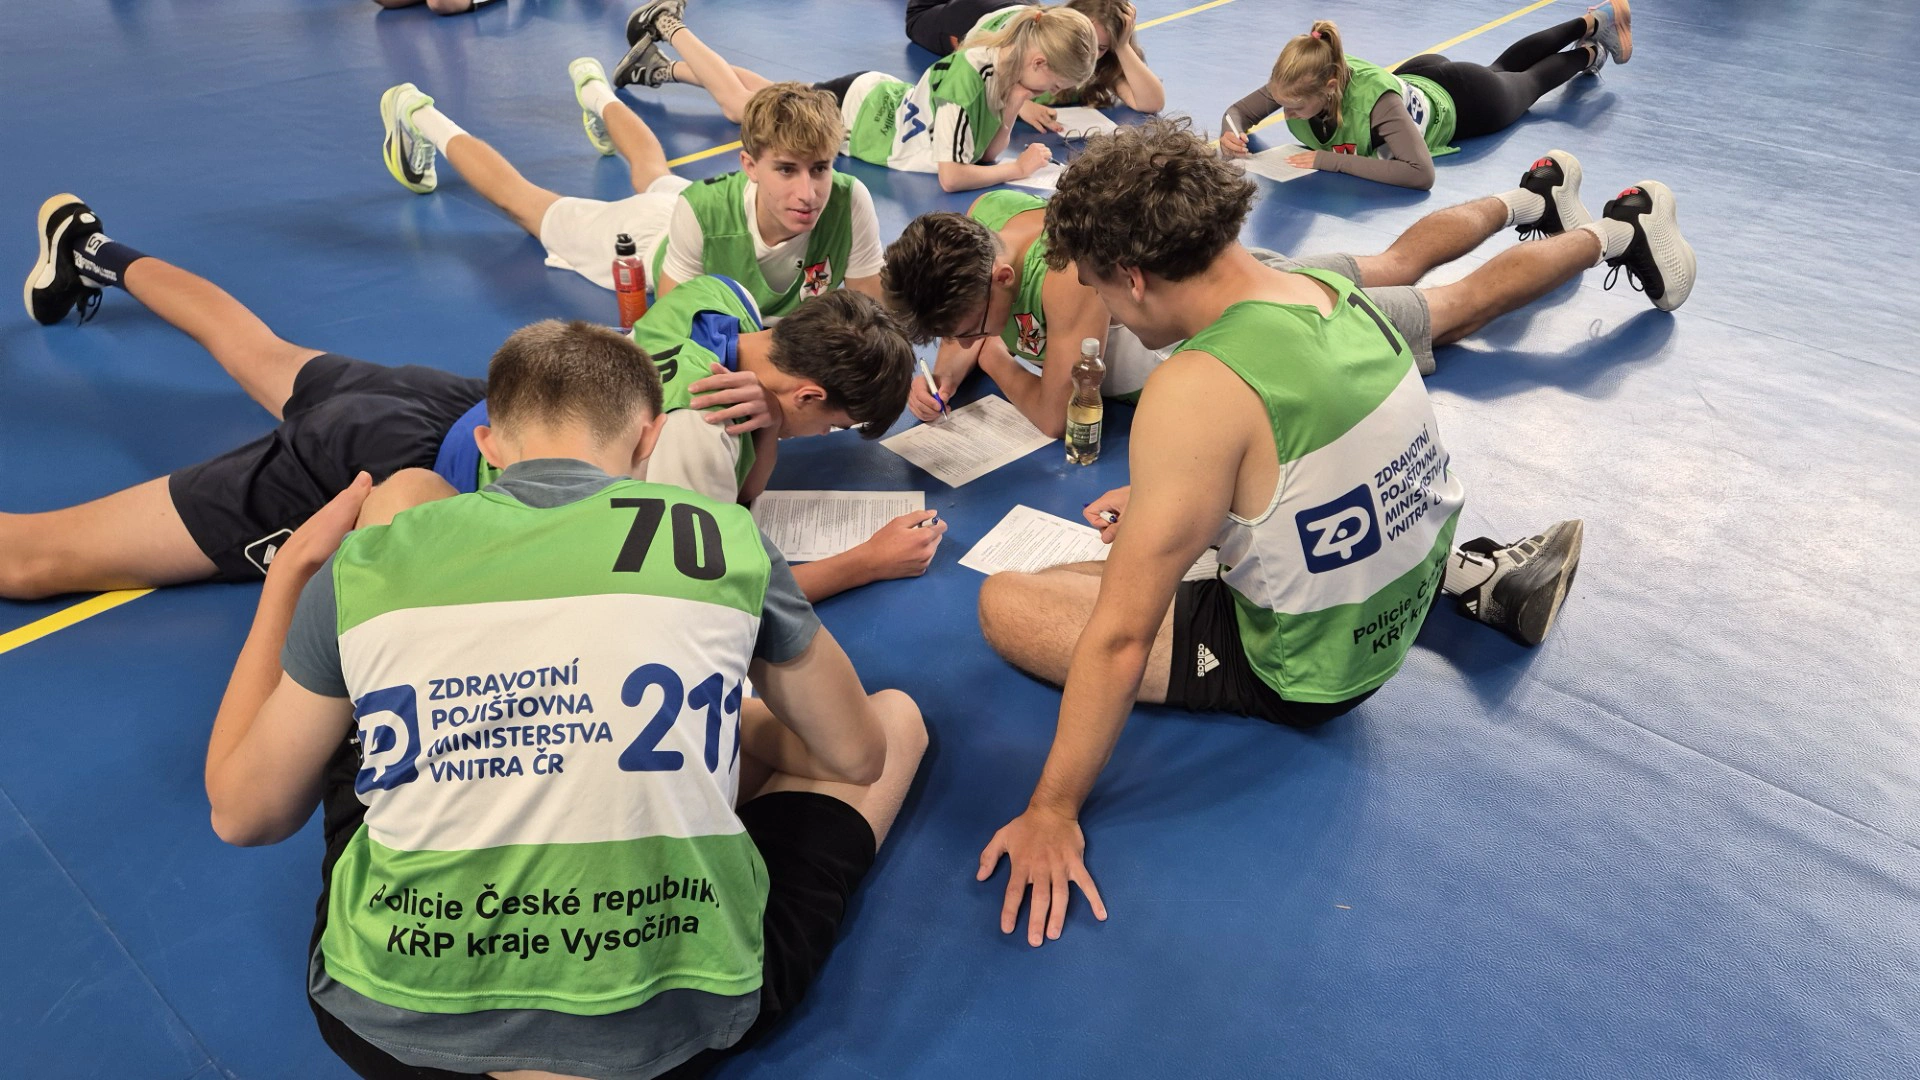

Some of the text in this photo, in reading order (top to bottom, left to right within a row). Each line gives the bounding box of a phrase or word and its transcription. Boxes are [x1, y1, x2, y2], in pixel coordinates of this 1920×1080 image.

[1374, 422, 1430, 488] ZDRAVOTNÍ
[609, 498, 727, 581] 70
[1387, 501, 1429, 541] VNITRA
[1353, 598, 1412, 645] Policie
[428, 657, 579, 700] ZDRAVOTNÍ
[1197, 643, 1205, 677] adidas
[432, 692, 594, 730] POJIŠŤOVNA
[427, 722, 613, 758] MINISTERSTVA
[429, 747, 564, 783] VNITRA ČR
[369, 875, 720, 920] Policie České republik
[387, 913, 699, 962] KŘP kraje Vysočina
